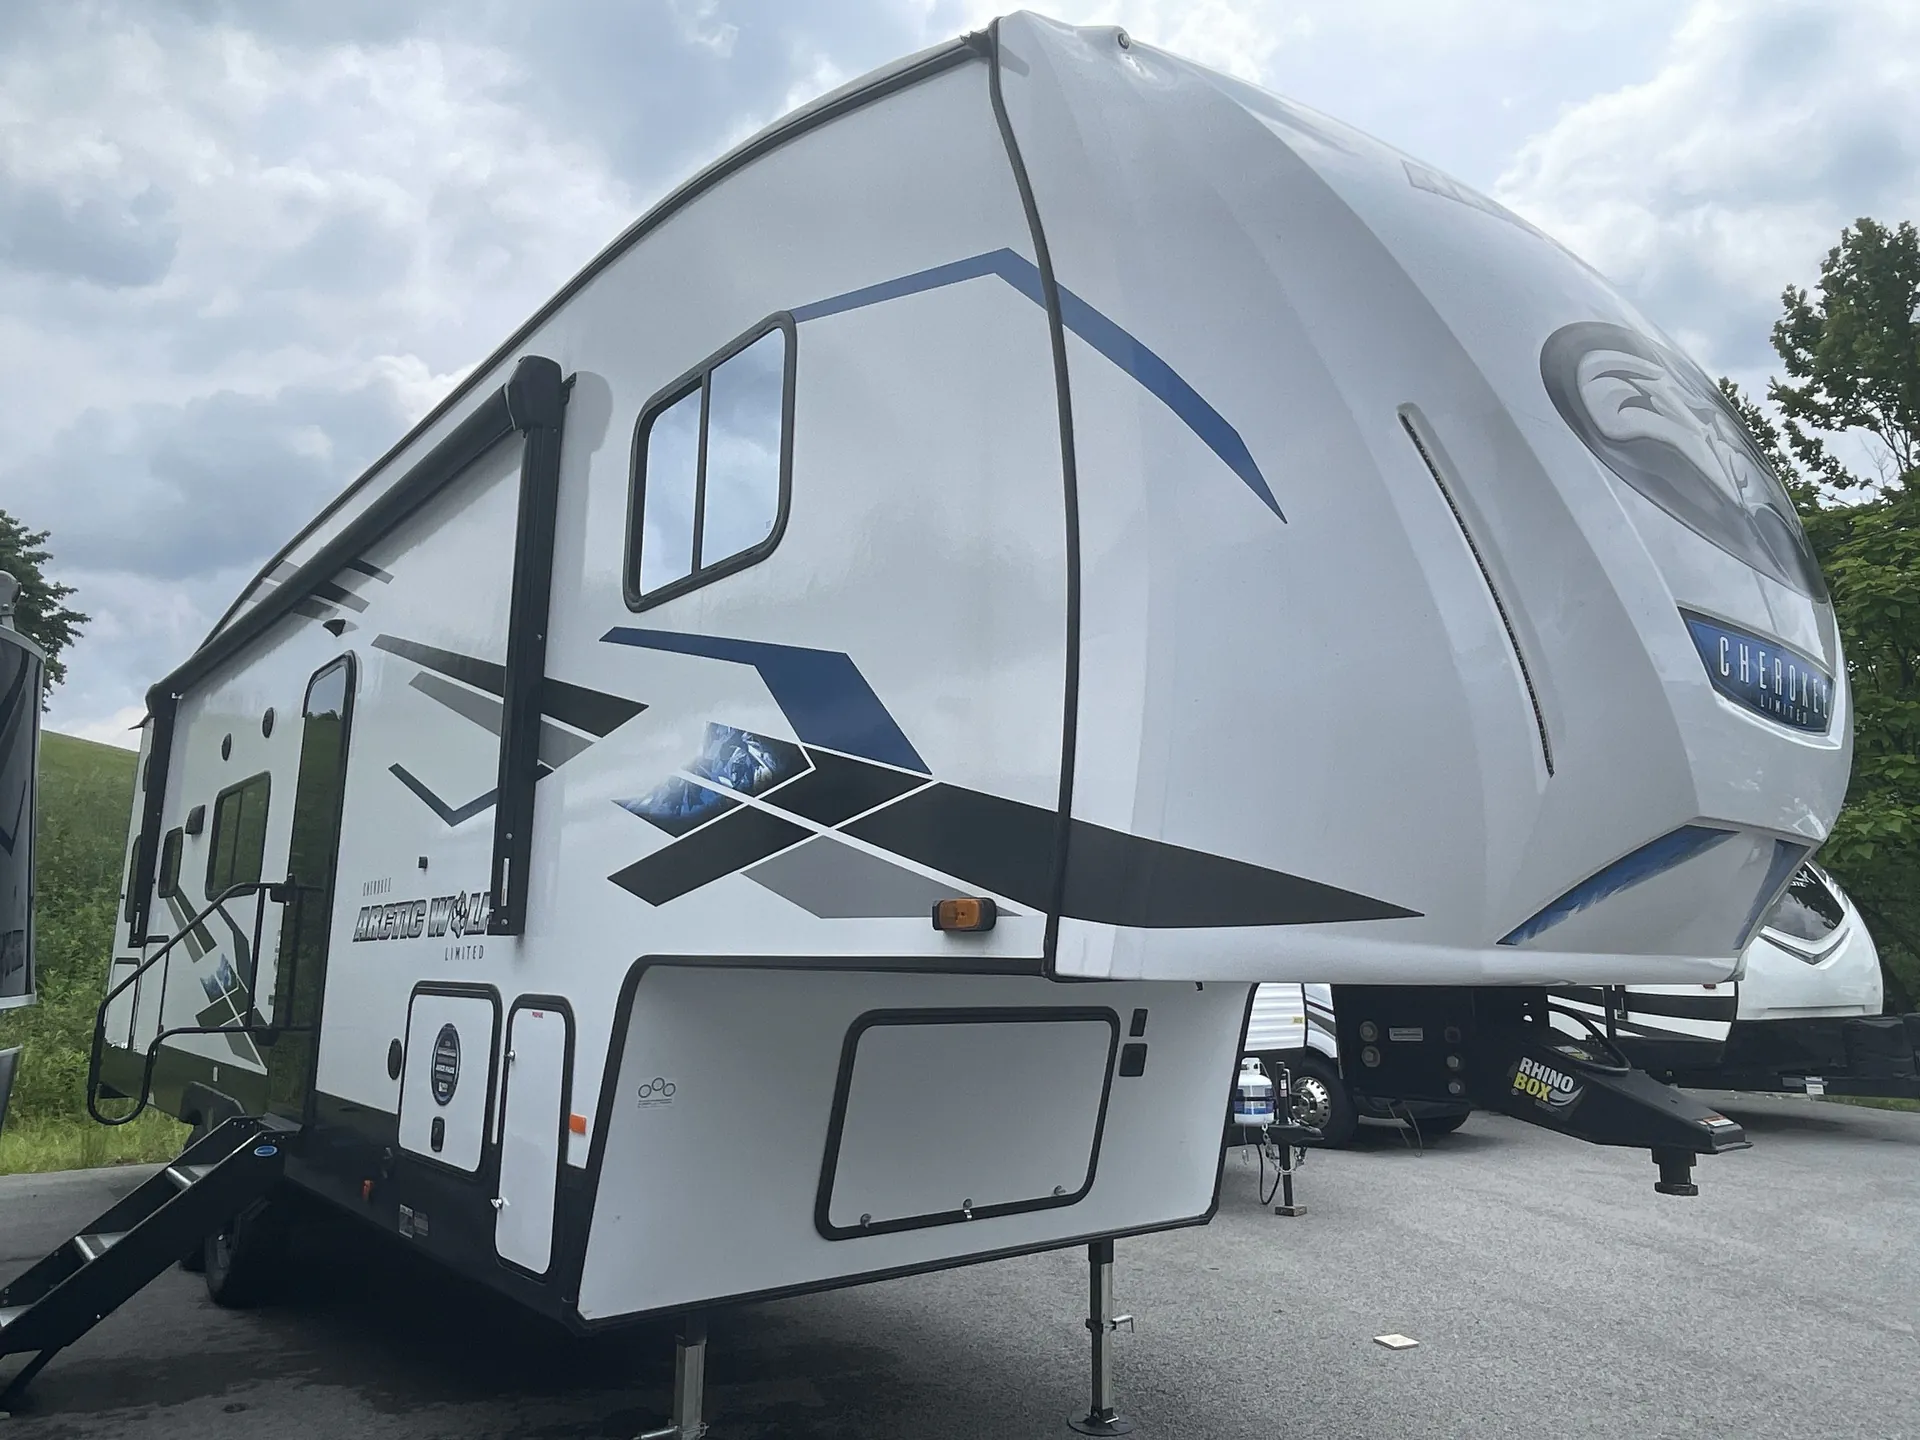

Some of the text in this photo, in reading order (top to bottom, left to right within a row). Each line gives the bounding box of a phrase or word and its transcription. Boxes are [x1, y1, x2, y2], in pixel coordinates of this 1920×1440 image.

[1719, 636, 1828, 719] CHEROKEE
[1760, 694, 1807, 724] LIMITED
[352, 899, 427, 943] ARCTIC
[445, 945, 484, 961] LIMITED
[1513, 1072, 1553, 1103] BOX
[1518, 1056, 1575, 1094] RHINO
